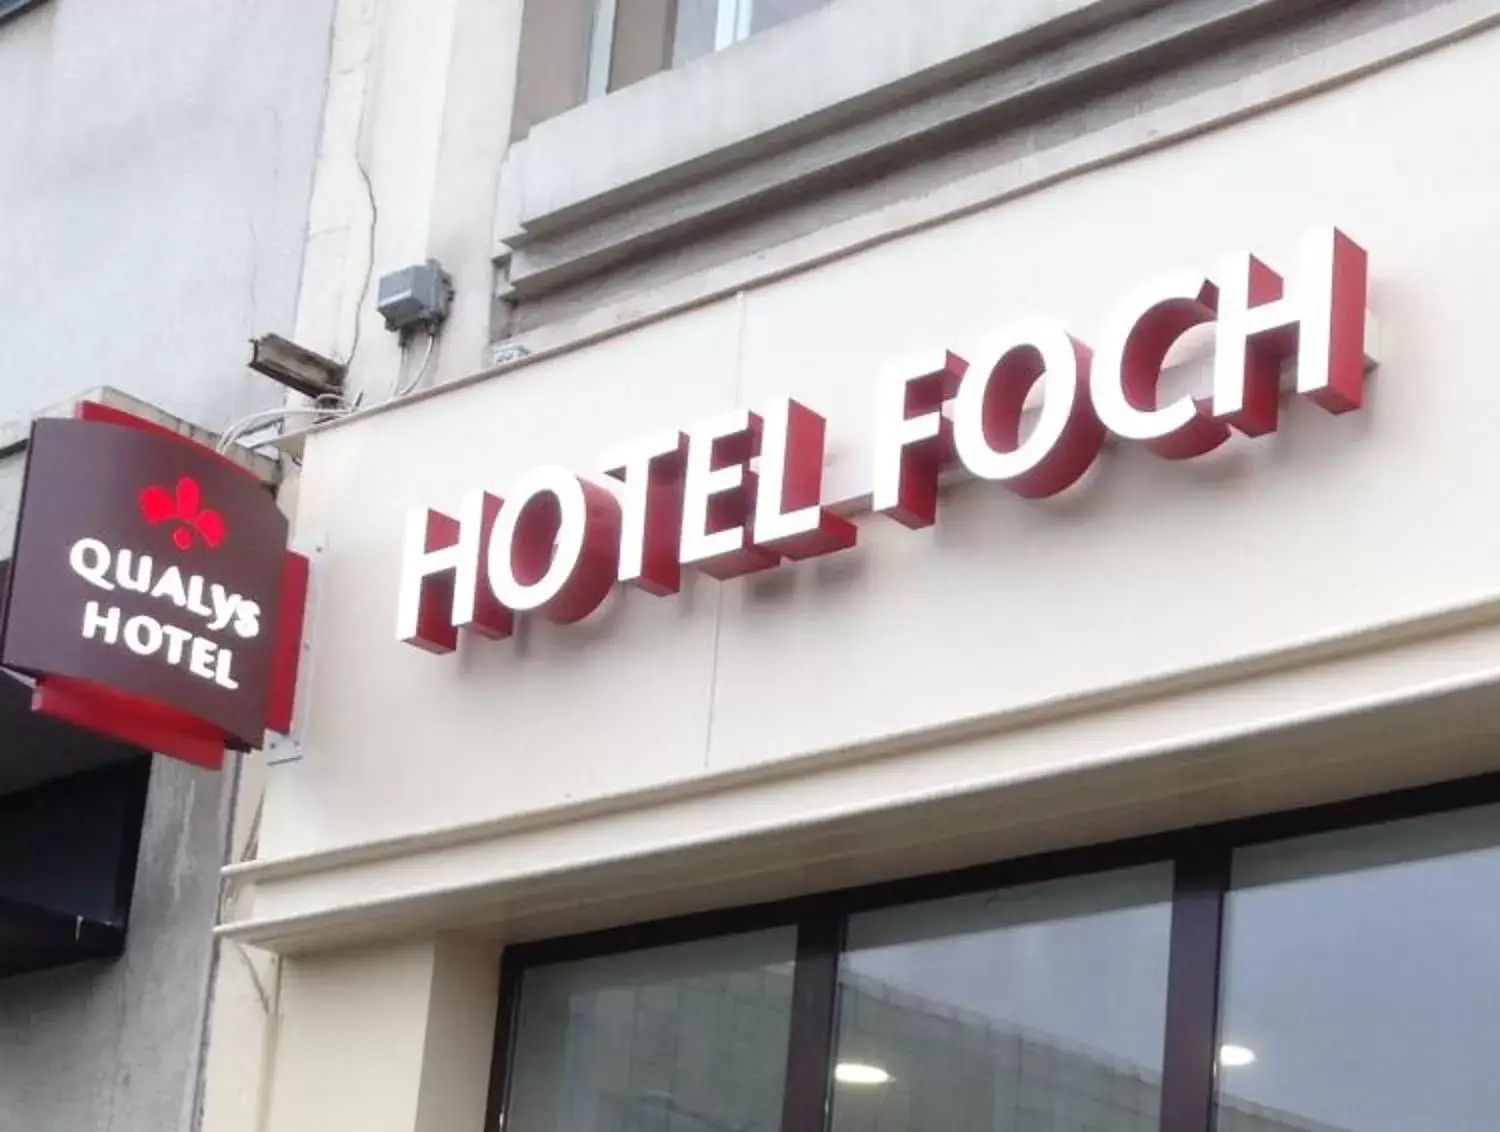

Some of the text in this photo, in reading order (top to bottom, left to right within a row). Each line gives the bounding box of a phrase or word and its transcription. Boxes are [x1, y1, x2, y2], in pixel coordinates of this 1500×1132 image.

[397, 226, 1342, 648] HOTEL FOCH
[70, 537, 262, 638] QUALYS
[81, 601, 239, 689] HOTEL
